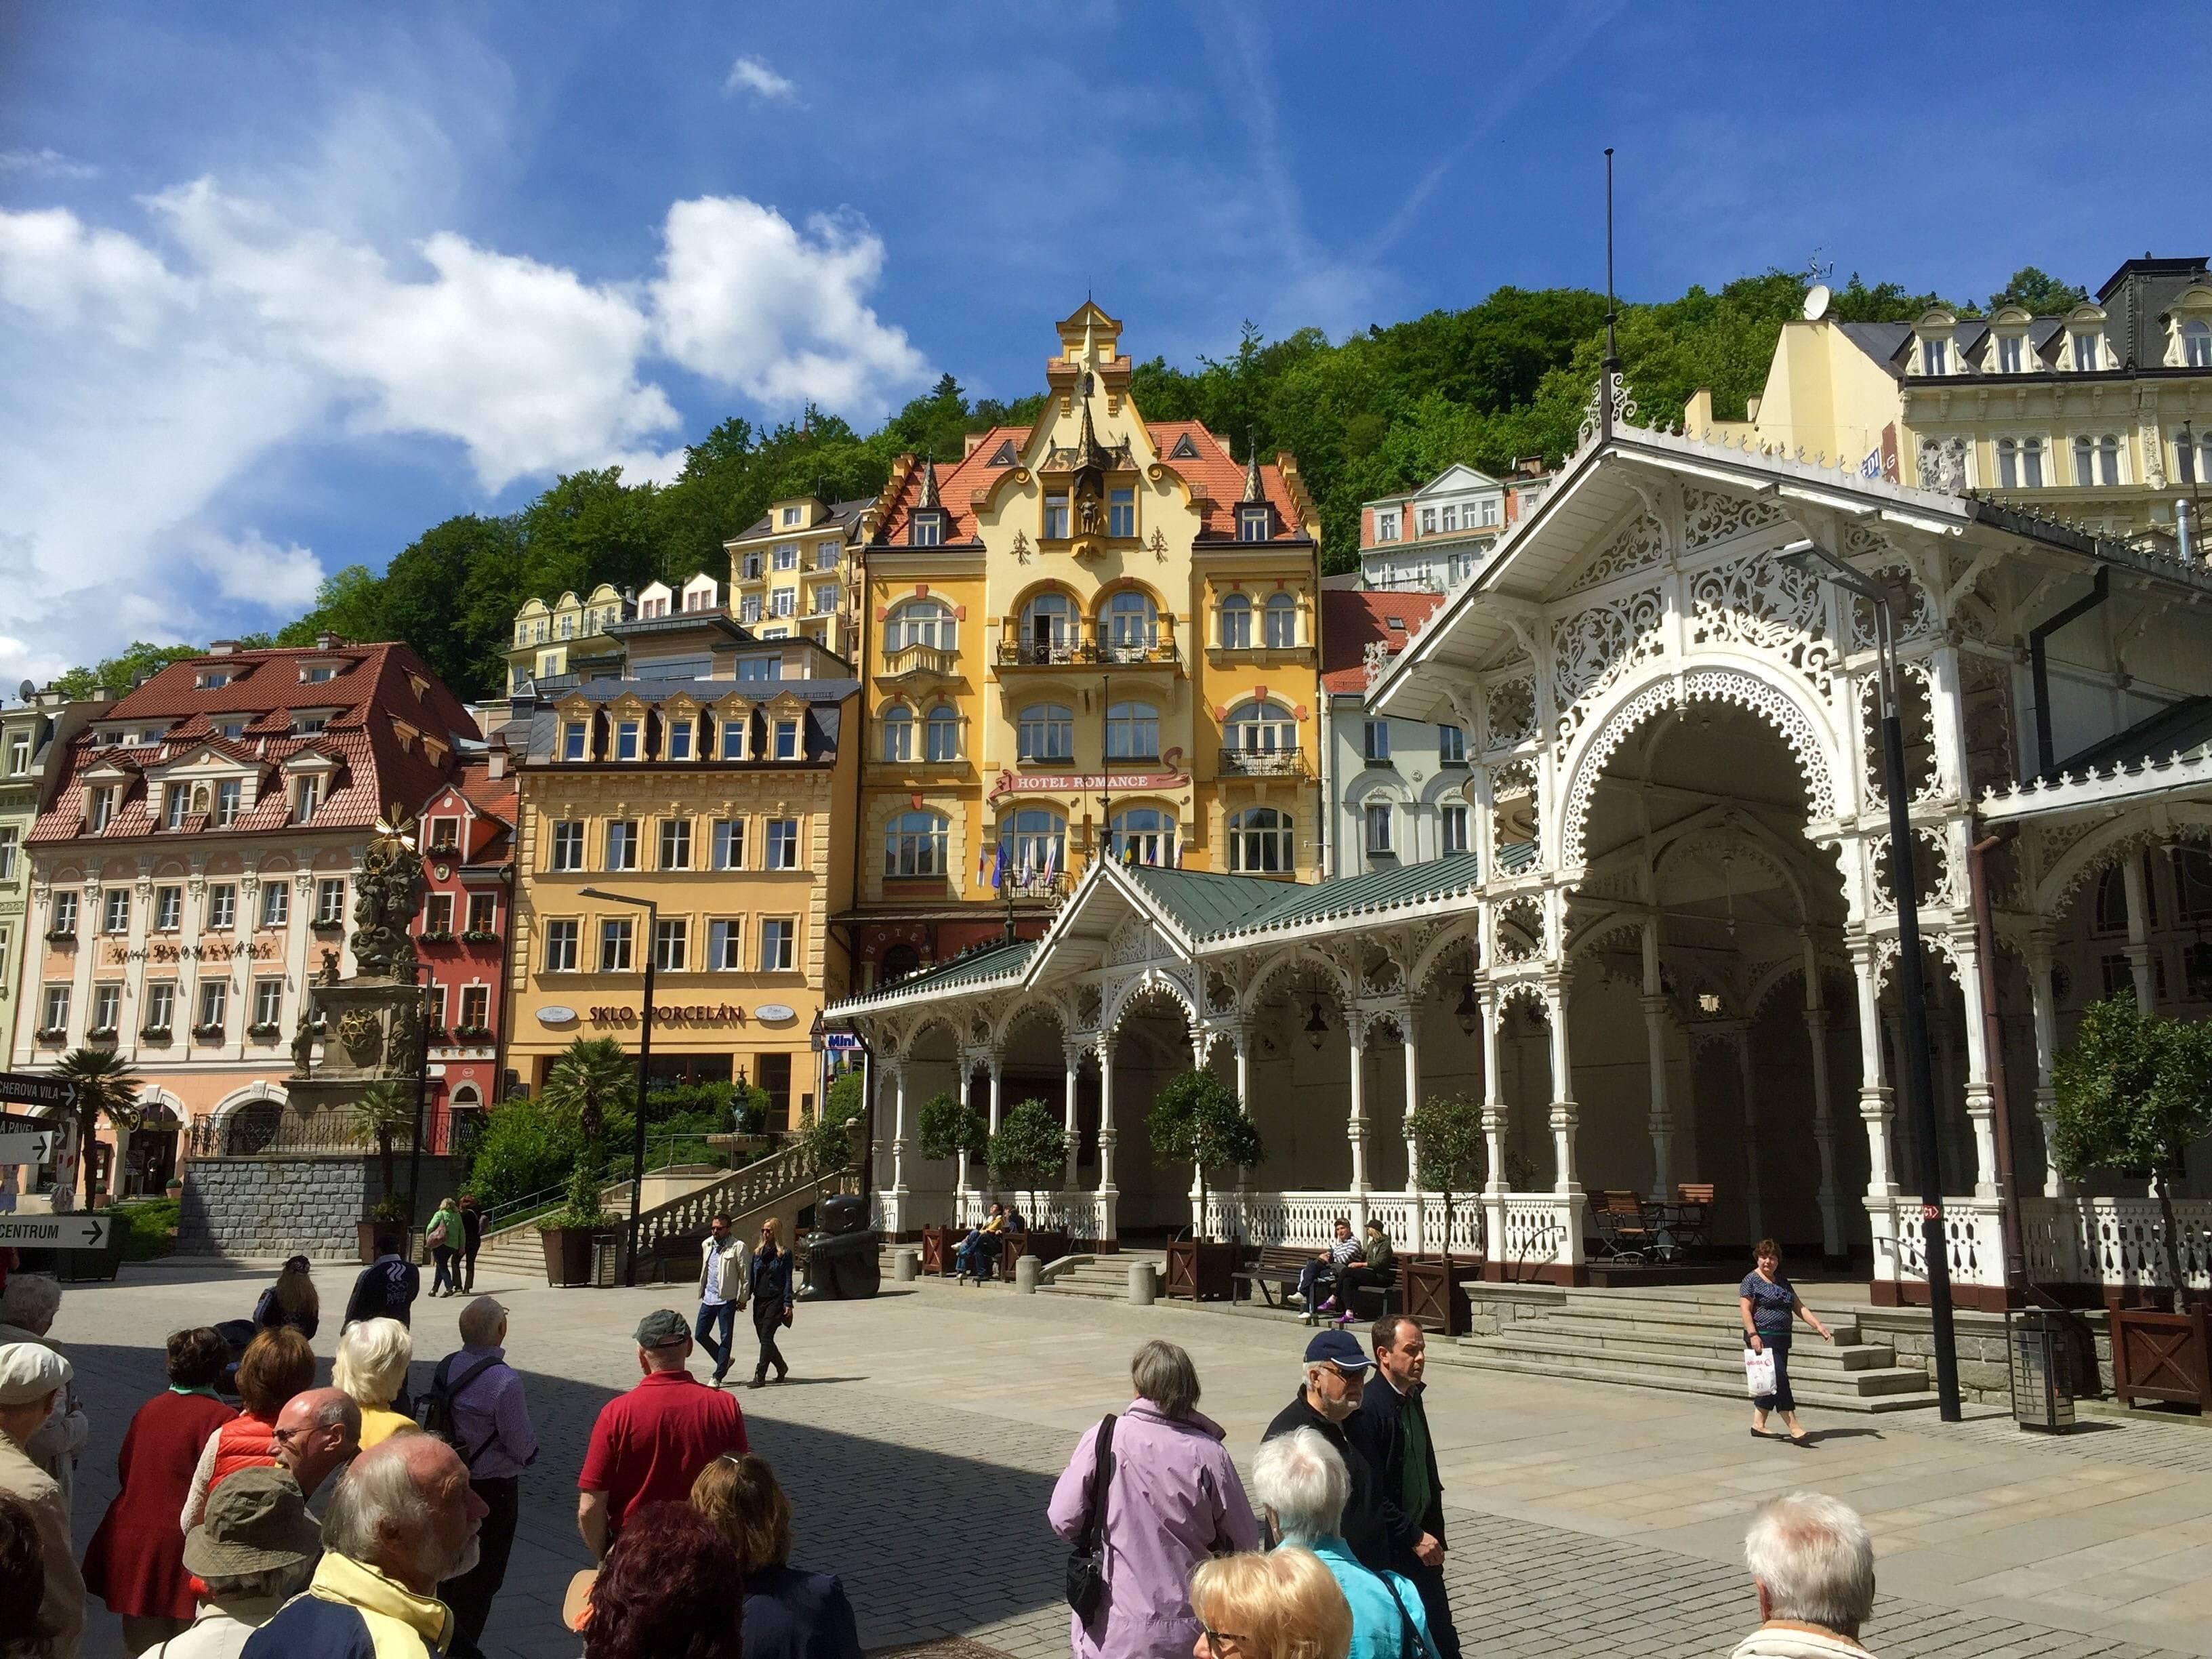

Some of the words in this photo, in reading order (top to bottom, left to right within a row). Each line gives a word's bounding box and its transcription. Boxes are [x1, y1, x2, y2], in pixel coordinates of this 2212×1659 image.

[1018, 777, 1069, 788] HOTEL
[1073, 776, 1148, 787] ROMANCE
[590, 1006, 633, 1021] SKLO
[651, 1002, 745, 1021] PORCELÁN
[40, 1086, 59, 1099] VILA
[0, 1224, 59, 1239] CENTRUM
